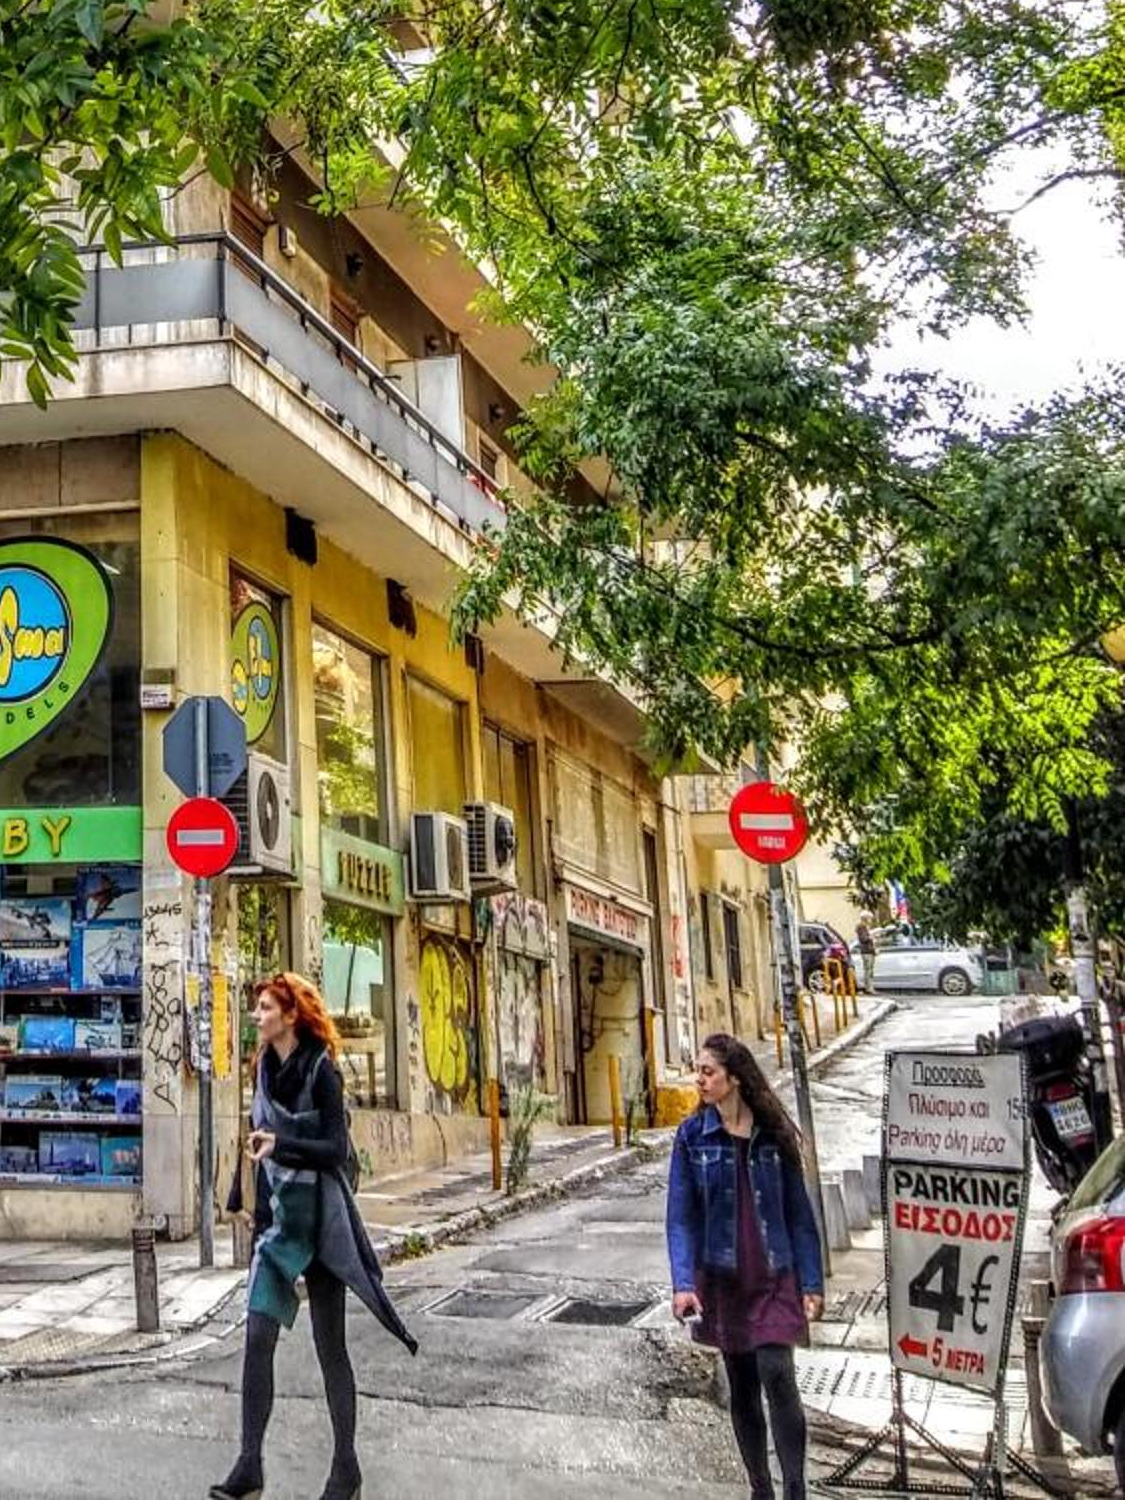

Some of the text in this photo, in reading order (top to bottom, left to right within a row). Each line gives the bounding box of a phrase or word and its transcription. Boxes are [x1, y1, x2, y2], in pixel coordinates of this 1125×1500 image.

[908, 1093, 966, 1121] Πλύσιμο
[967, 1100, 990, 1119] και
[888, 1123, 941, 1154] Parking
[971, 1131, 1006, 1157] μέρα
[893, 1169, 1021, 1209] PARKING
[894, 1201, 1017, 1242] ΕΙΣΟΔΟΣ
[932, 1337, 985, 1375] 5 ΜΕΤΡΑ
